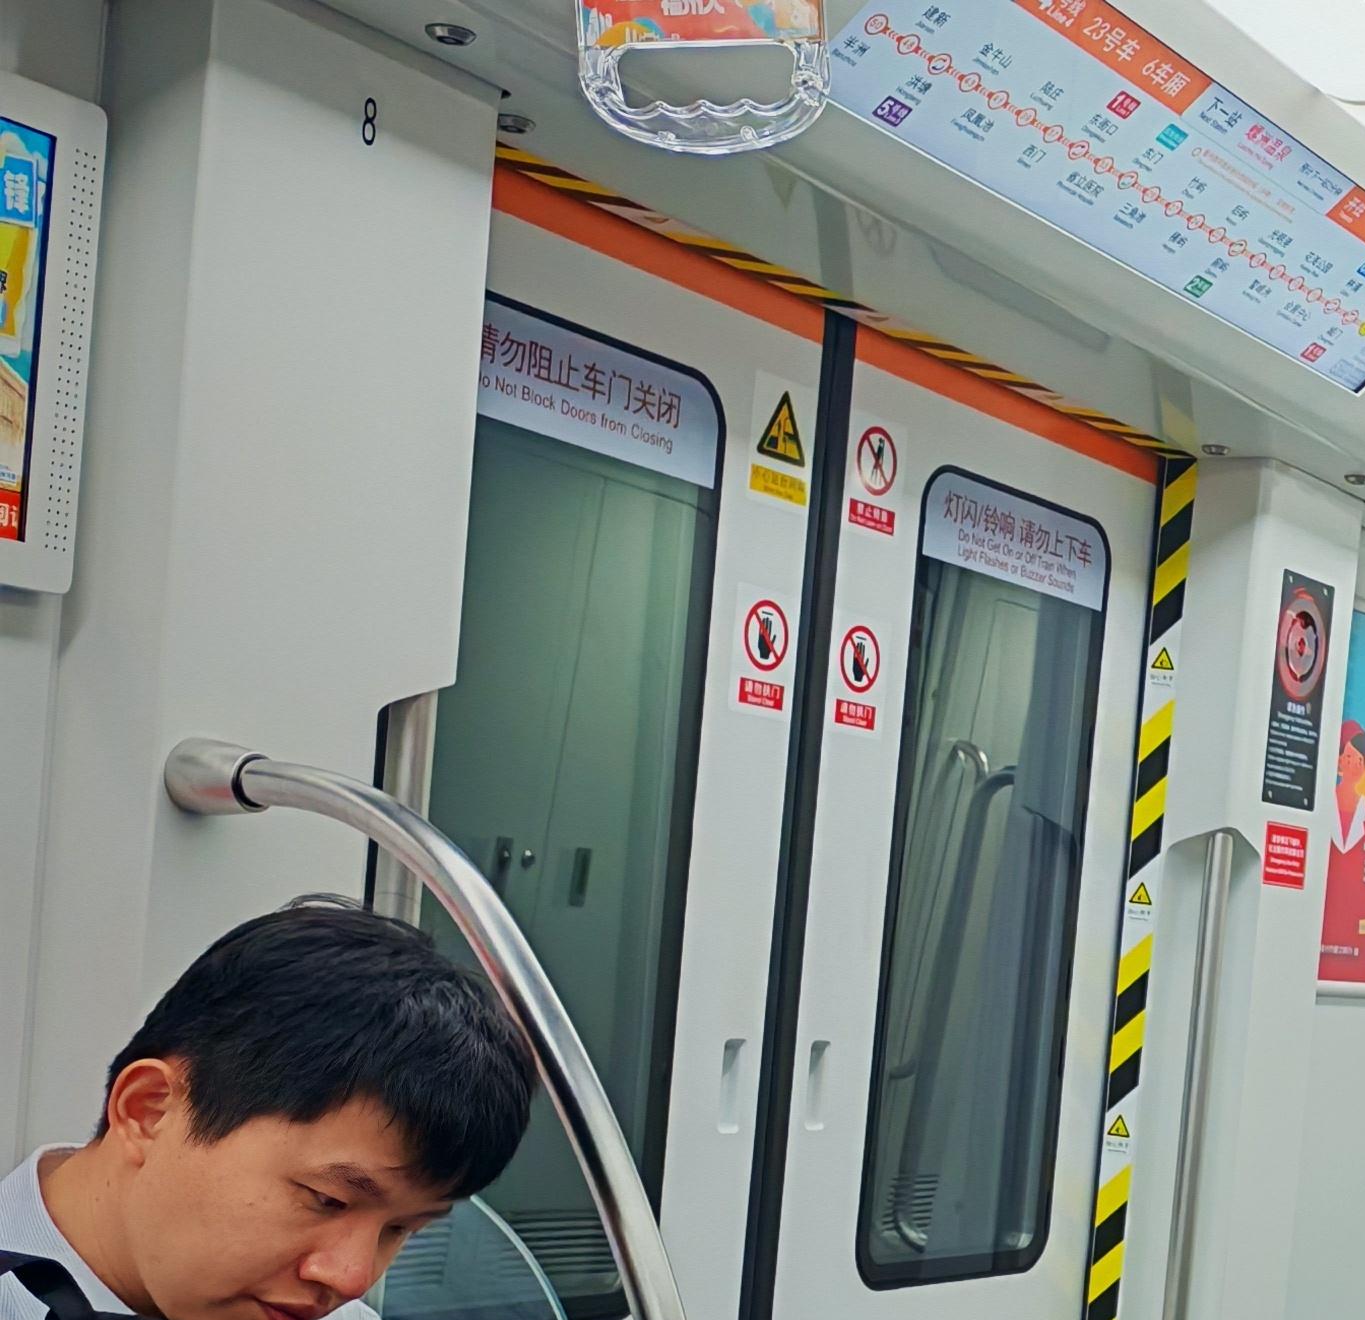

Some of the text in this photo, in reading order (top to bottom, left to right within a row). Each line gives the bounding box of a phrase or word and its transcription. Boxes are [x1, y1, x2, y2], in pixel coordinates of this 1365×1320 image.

[1082, 17, 1192, 97] 23号车 6车厢
[361, 96, 378, 147] 8
[1207, 96, 1243, 129] 下一站
[480, 322, 682, 430] 请勿阻止车门关闭
[494, 375, 518, 397] Not
[521, 386, 556, 411] Block
[560, 399, 597, 426] Doors
[600, 413, 627, 435] from
[631, 423, 673, 455] Closing
[1020, 518, 1092, 568] 请勿上下车
